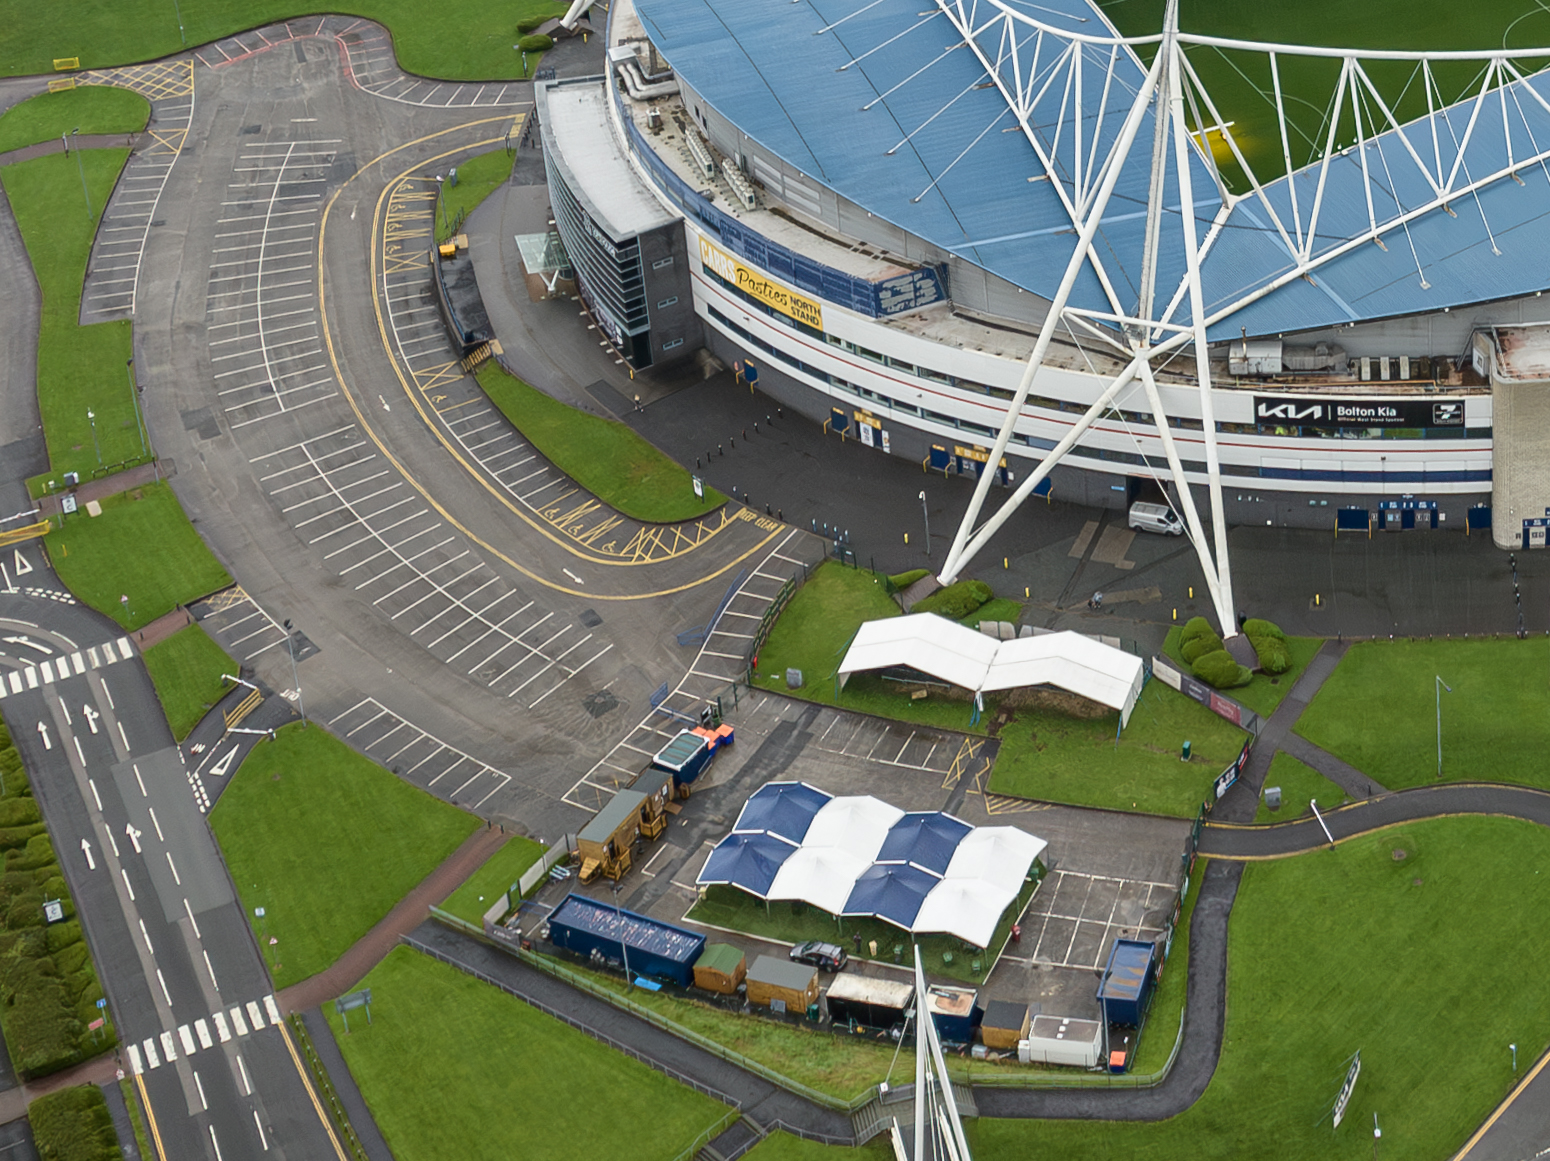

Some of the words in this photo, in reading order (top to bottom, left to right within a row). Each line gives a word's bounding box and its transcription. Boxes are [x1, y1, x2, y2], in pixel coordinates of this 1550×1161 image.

[701, 240, 736, 284] CARRS
[737, 268, 788, 306] Pasties
[790, 295, 821, 317] NORTH
[790, 306, 820, 326] STAND
[1337, 407, 1376, 417] Bolton
[1377, 406, 1397, 417] Kia
